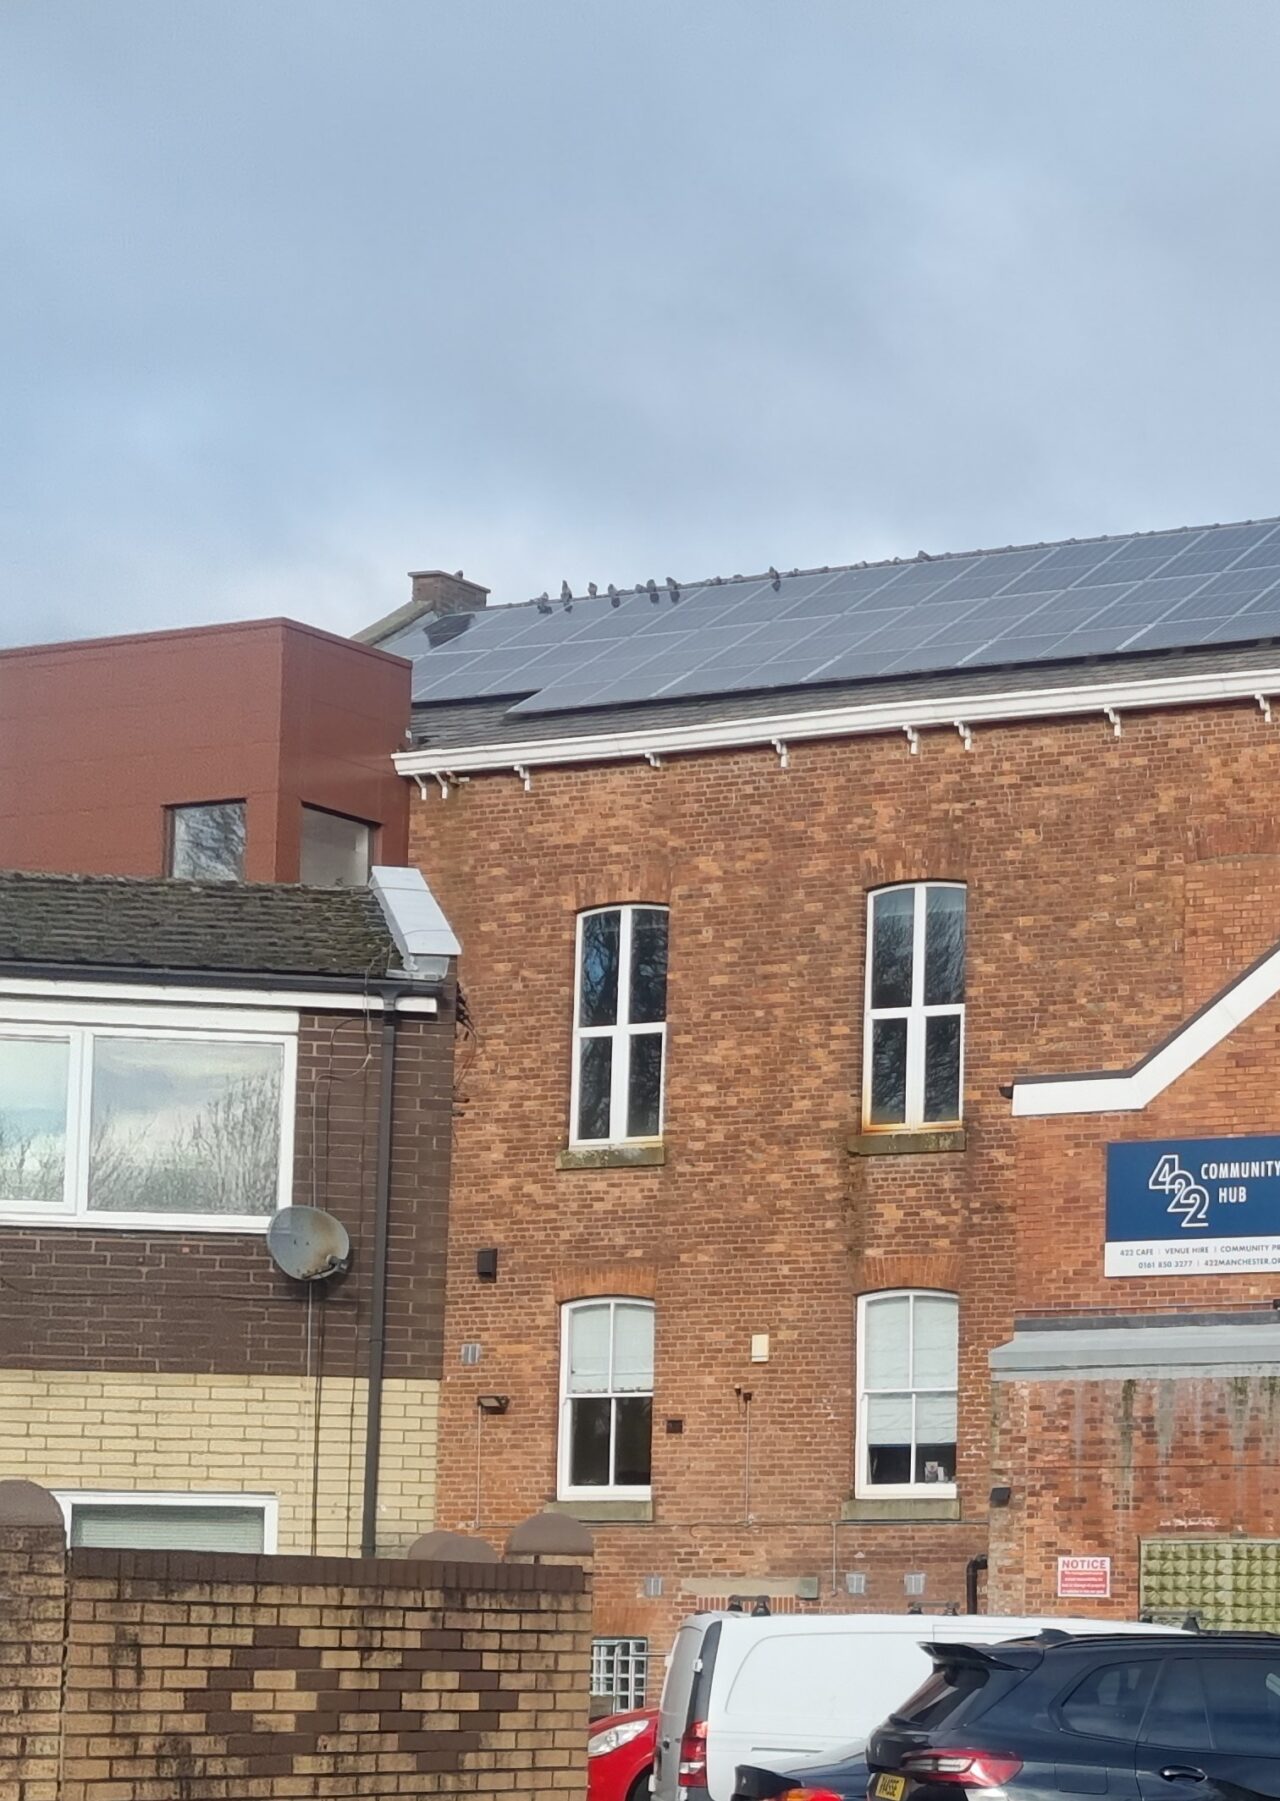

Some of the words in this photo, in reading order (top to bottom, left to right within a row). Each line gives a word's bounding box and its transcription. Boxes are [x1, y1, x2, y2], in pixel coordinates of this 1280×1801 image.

[1149, 1154, 1209, 1228] 422
[1218, 1186, 1247, 1203] HUB
[1120, 1249, 1134, 1257] 422
[1136, 1248, 1154, 1256] CAFE
[1165, 1247, 1190, 1255] VENUE
[1192, 1246, 1209, 1254] HIRE
[1220, 1244, 1270, 1253] COMMUNITY
[1062, 1559, 1106, 1569] NOTICE
